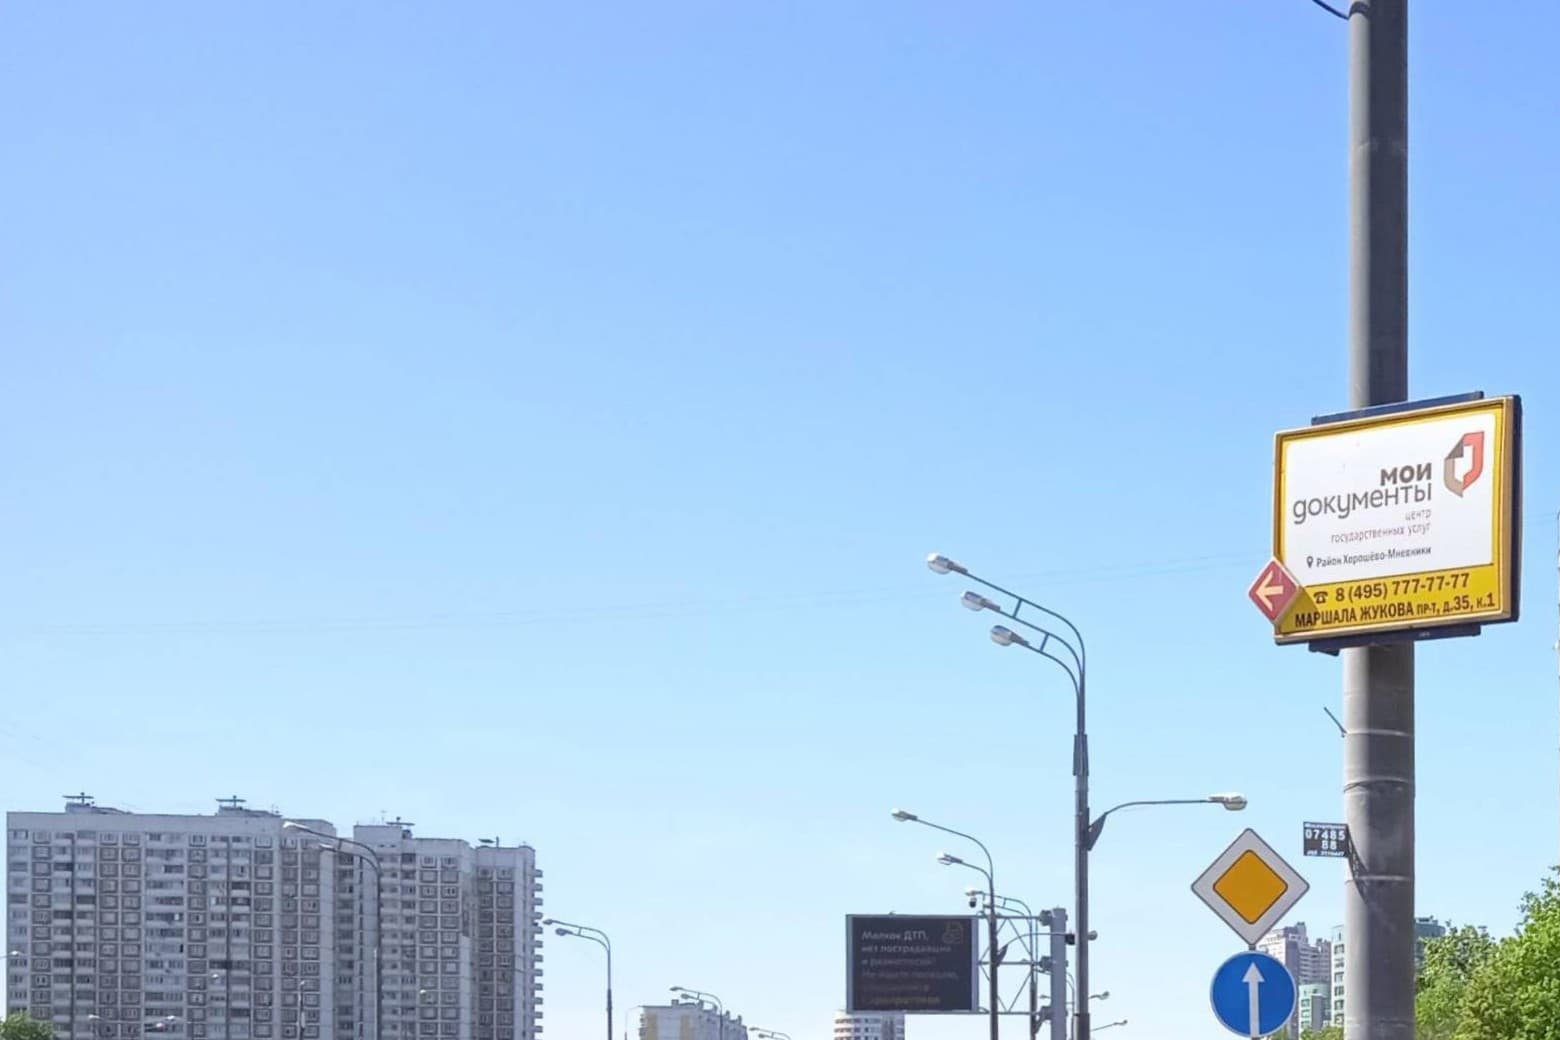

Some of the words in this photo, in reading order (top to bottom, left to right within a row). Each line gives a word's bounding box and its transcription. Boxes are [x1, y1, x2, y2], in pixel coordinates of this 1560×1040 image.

[1293, 483, 1432, 525] документы
[1405, 509, 1432, 521] центр
[1331, 526, 1404, 544] государственных
[1408, 523, 1431, 537] услуг
[1316, 556, 1342, 568] Район
[1335, 586, 1344, 601] 8
[1348, 580, 1388, 603] (495)
[1392, 573, 1470, 596] 777-77-77
[1295, 605, 1357, 628] МАРШАЛА
[1360, 601, 1414, 621] ЖУКОВА
